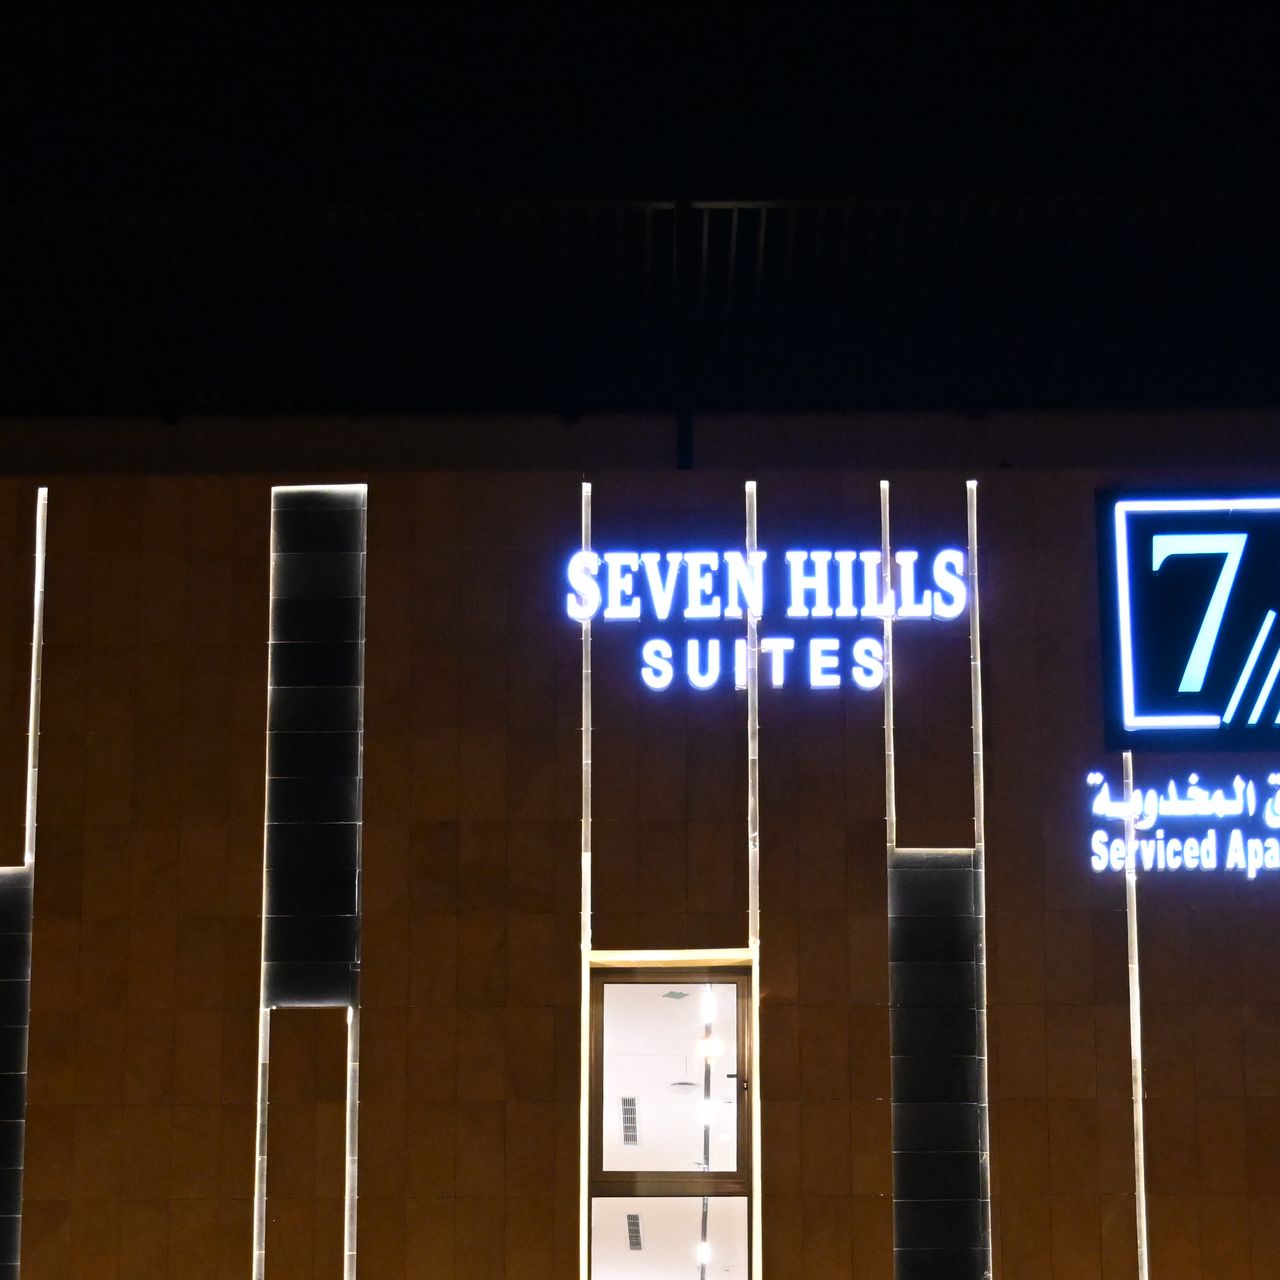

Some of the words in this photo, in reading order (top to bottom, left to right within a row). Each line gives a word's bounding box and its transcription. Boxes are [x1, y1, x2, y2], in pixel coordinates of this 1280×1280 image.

[566, 549, 767, 621] SEVEN
[785, 549, 967, 620] HILLS
[1152, 533, 1248, 693] 7
[640, 638, 885, 690] SUITES
[1091, 828, 1218, 872] Serviced
